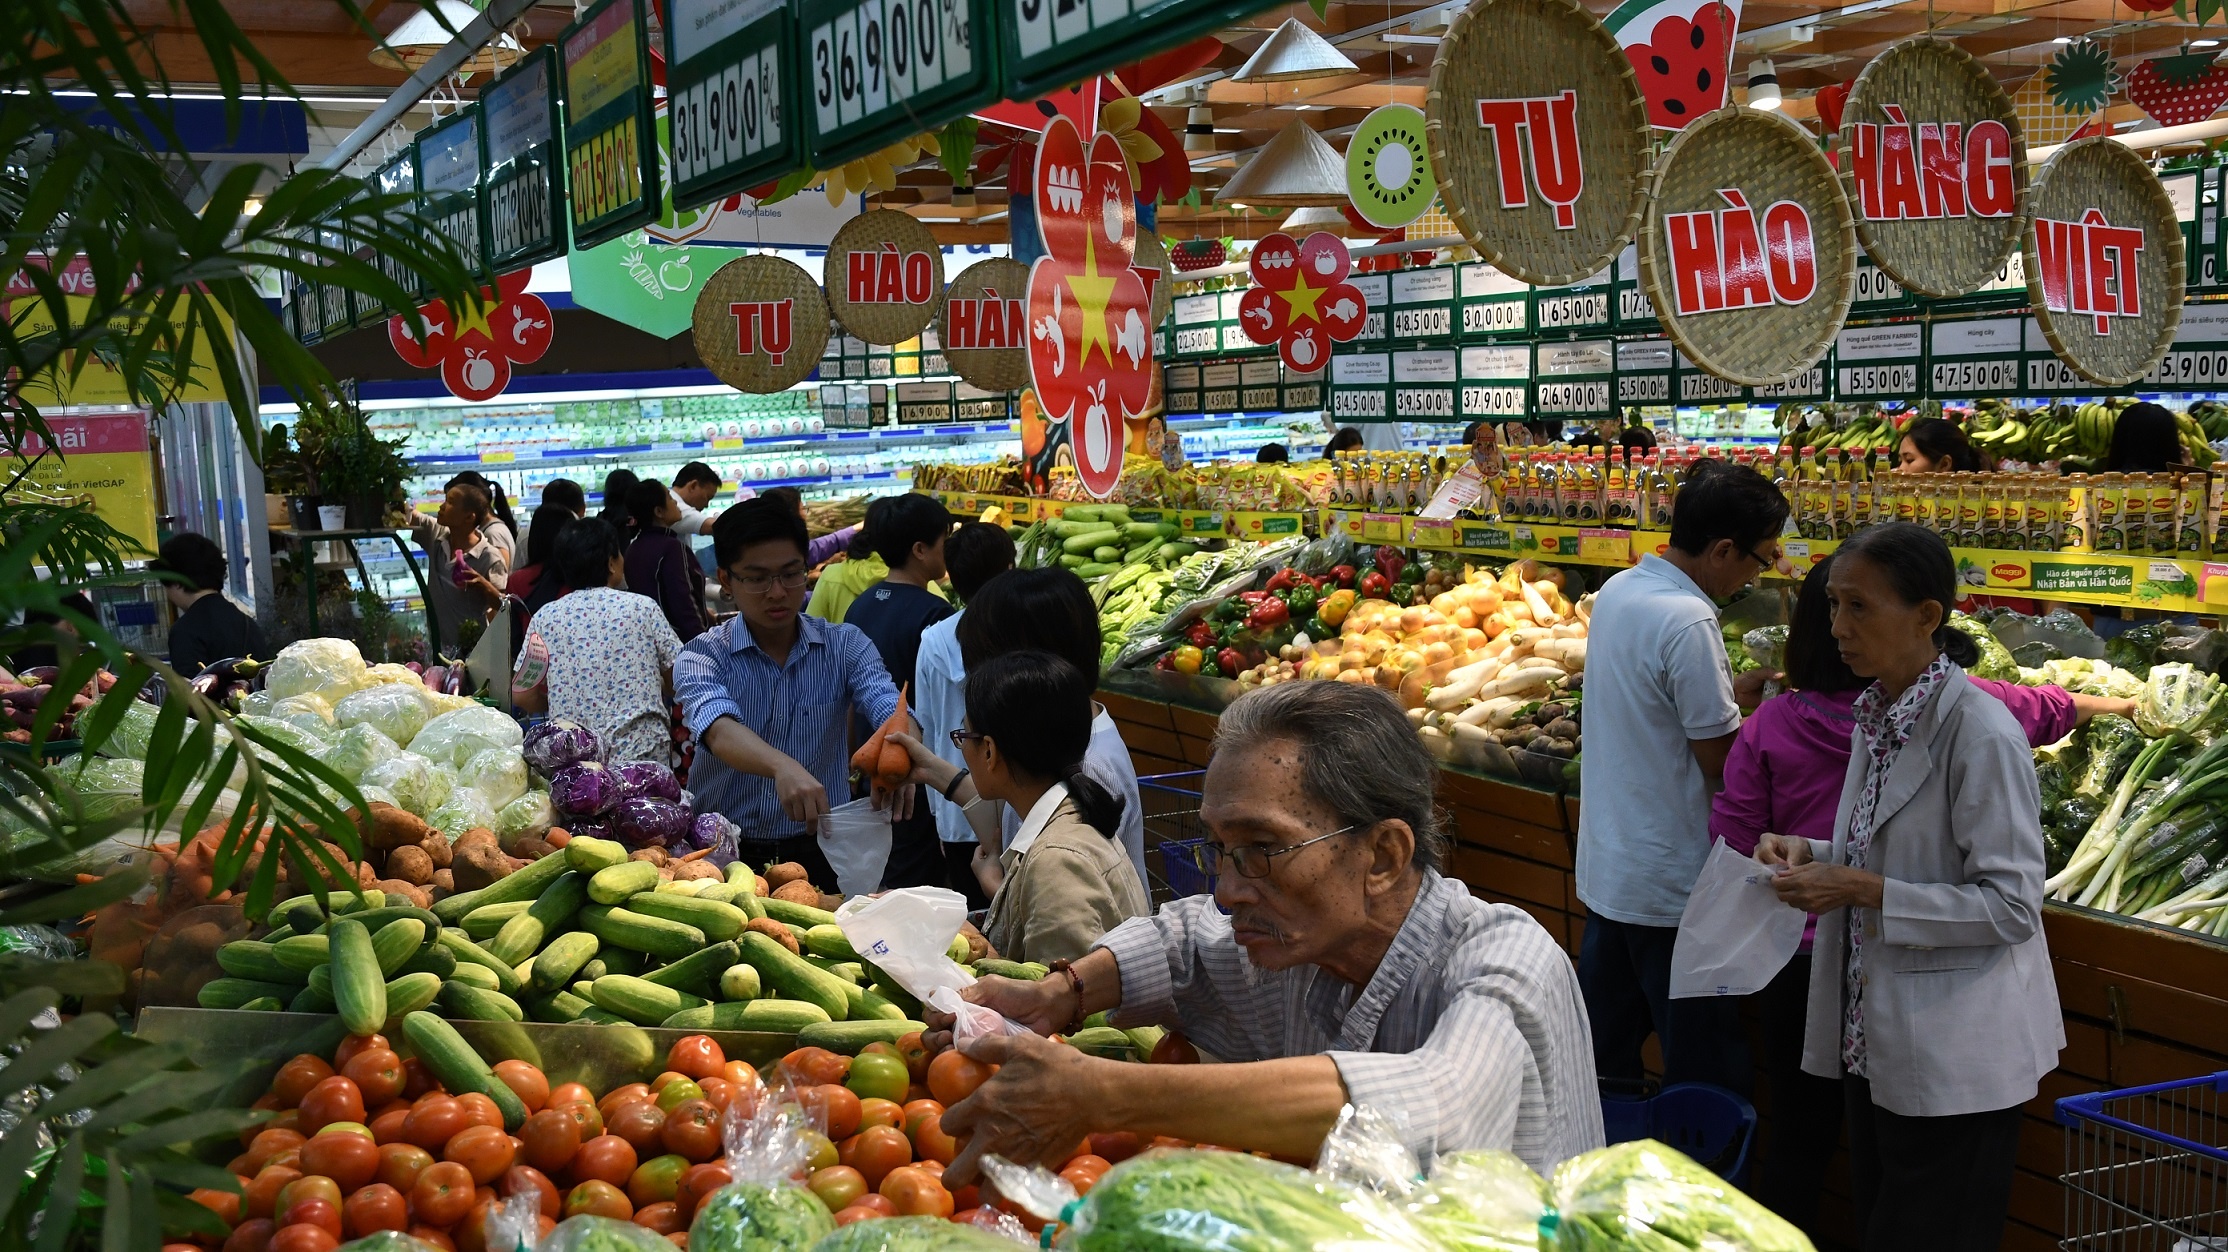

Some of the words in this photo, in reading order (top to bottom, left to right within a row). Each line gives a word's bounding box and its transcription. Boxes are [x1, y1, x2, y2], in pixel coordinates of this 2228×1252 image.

[816, 0, 937, 107] 36.900
[677, 77, 757, 163] 31.900
[1476, 89, 1584, 230] TỰ
[1853, 103, 2016, 221] HÀNG
[574, 138, 626, 214] 27.500
[736, 206, 782, 218] Vegetables
[1663, 188, 1818, 316] HÀO
[847, 241, 934, 304] HÀO
[2035, 207, 2145, 337] VIỆT
[1622, 293, 1653, 315] 17.9
[948, 287, 1028, 350] HÀN
[1395, 312, 1439, 333] 48.500
[1465, 306, 1513, 328] 30.000
[2184, 315, 2197, 324] trái
[2198, 315, 2214, 324] siêu
[729, 297, 794, 367] TỰ
[1178, 331, 1209, 349] 22.500
[1871, 333, 1891, 342] GREEN
[1892, 332, 1918, 340] FARMING
[1853, 370, 1901, 389] 5.500
[1935, 366, 2000, 387] 47.500
[2004, 364, 2017, 385] đ/kg
[1244, 391, 1270, 406] 18.000
[1290, 389, 1313, 404] 9.200
[1542, 387, 1595, 406] 26.900
[1620, 381, 1657, 398] 5.500
[1335, 395, 1376, 412] 34.500
[1397, 393, 1442, 411] 39.500
[1464, 390, 1512, 408] 37.900
[903, 406, 941, 418] 16.900
[960, 404, 997, 416] 38.500
[83, 479, 125, 490] VietGAP
[1995, 567, 2023, 577] Maggi
[2046, 568, 2060, 578] Hào
[2060, 568, 2070, 577] có
[2070, 567, 2092, 578] nguồn
[2093, 568, 2107, 579] gốc
[2108, 566, 2118, 576] từ
[2037, 579, 2056, 591] Nhật
[2058, 578, 2075, 590] Bản
[2075, 578, 2088, 588] và
[2089, 577, 2106, 588] Hàn
[2108, 576, 2131, 588] Quốc
